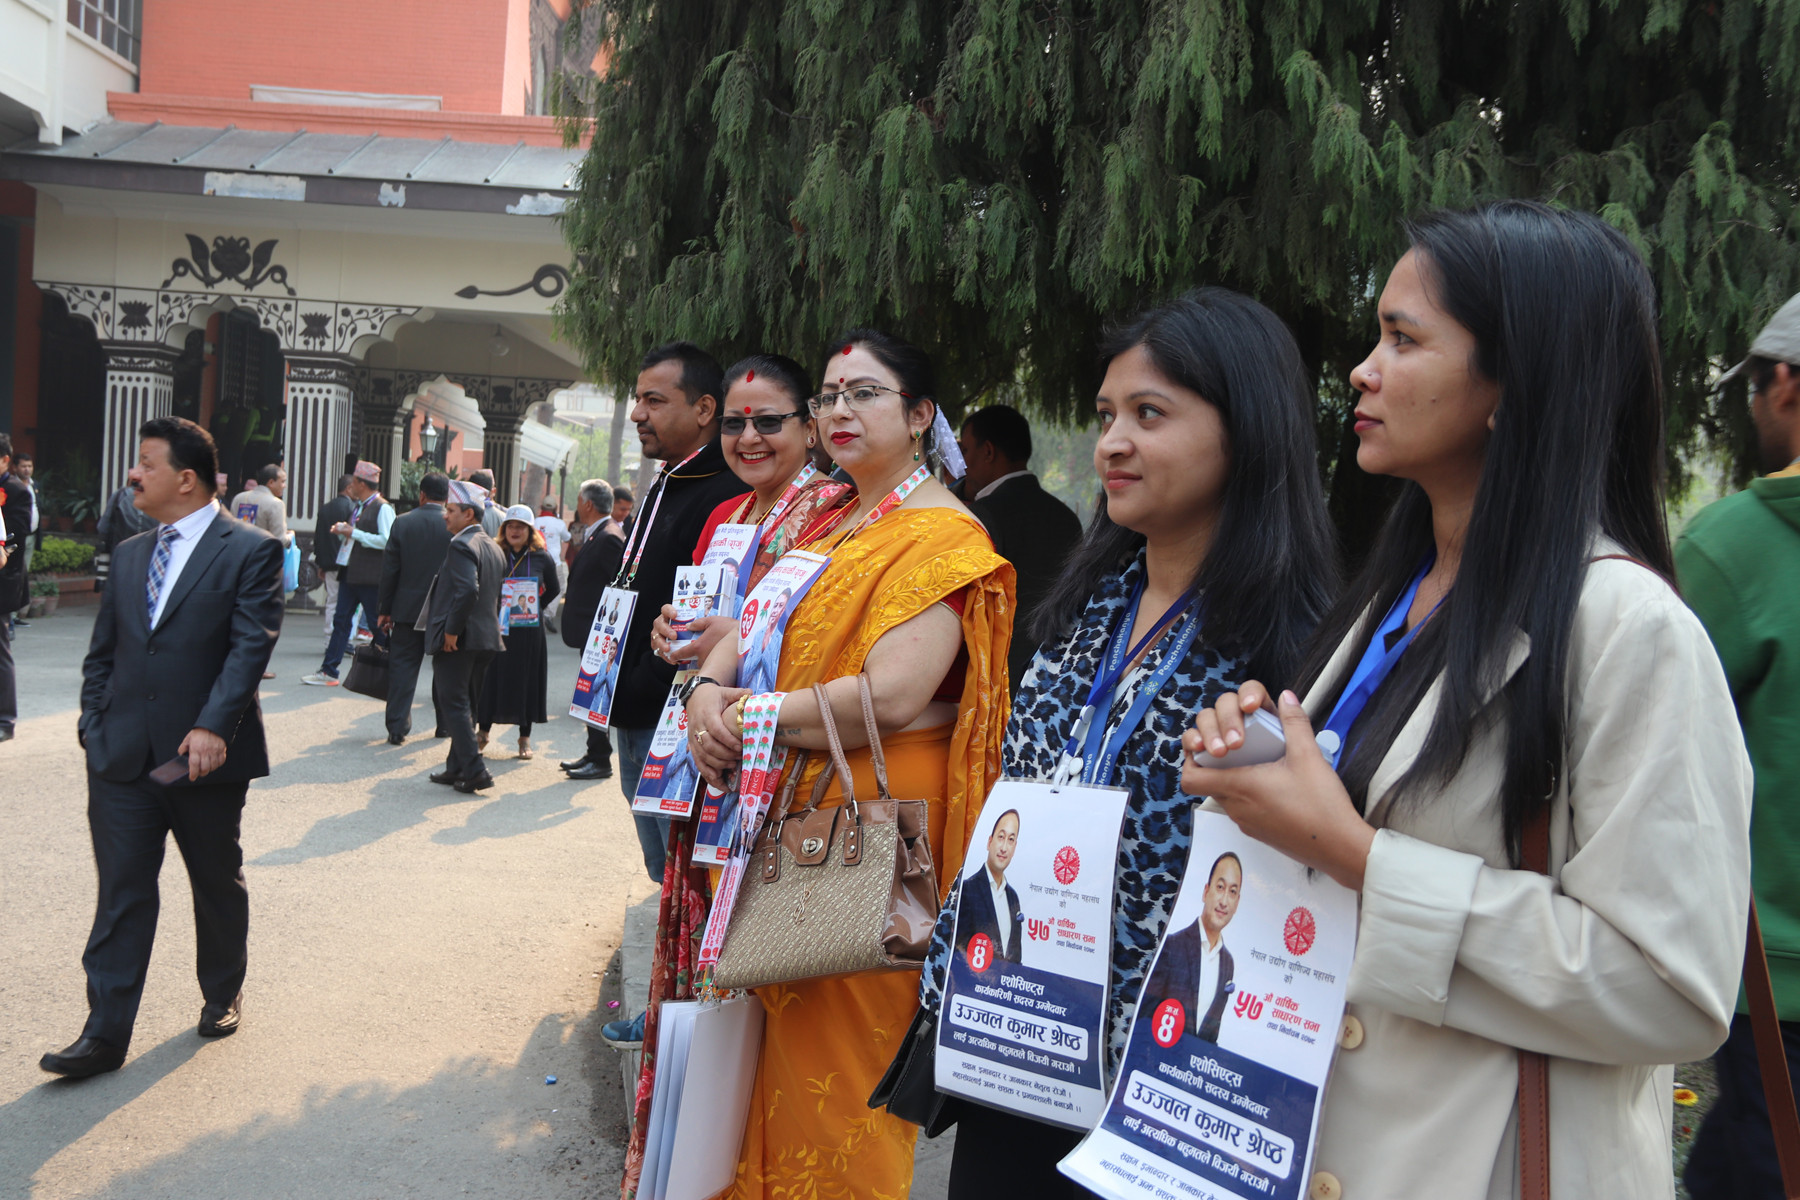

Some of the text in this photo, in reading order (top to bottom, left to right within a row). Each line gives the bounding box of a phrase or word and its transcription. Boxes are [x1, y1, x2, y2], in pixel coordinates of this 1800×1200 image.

[1109, 612, 1131, 671] Panchakanya
[1158, 617, 1198, 676] Panchakanya
[751, 770, 760, 793] FNCCI
[766, 770, 780, 791] FNCCI
[1028, 918, 1049, 941] ५७
[972, 946, 986, 968] ४
[1251, 947, 1336, 984] नेपाल उद्योग वाणिज्य महासंघ
[1001, 974, 1044, 996] एशोसिएट्स
[1284, 973, 1293, 984] को
[975, 984, 1067, 1016] कार्यकारिणी सदस्य उम्मेदवार
[1233, 991, 1263, 1020] ५७
[1275, 996, 1300, 1012] वार्षिक
[955, 1002, 1082, 1051] उज्ज्वल कुमार श्रेष्ठ
[1157, 1014, 1175, 1043] ४
[1272, 1008, 1321, 1032] साधारण सभा
[954, 1030, 966, 1043] लाई
[968, 1034, 997, 1050] अत्यधिक
[998, 1044, 1025, 1060] बहुमतले
[1027, 1050, 1049, 1066] विजयी
[1190, 1054, 1244, 1088] एशोसिएट्स
[1159, 1062, 1270, 1119] कार्यकारिणी सदस्य उम्मेदवार
[1132, 1081, 1286, 1164] उज्ज्वल कुमार श्रेष्ठ
[1123, 1115, 1141, 1132] लाई
[1141, 1122, 1178, 1147] अत्यधिक
[1177, 1140, 1211, 1165] बहुमतले
[1211, 1154, 1239, 1179] विजयी
[1099, 1159, 1139, 1184] महासंघलाई
[1140, 1162, 1170, 1183] इमान्दार
[1171, 1176, 1177, 1186] र
[1177, 1180, 1206, 1199] जानकार
